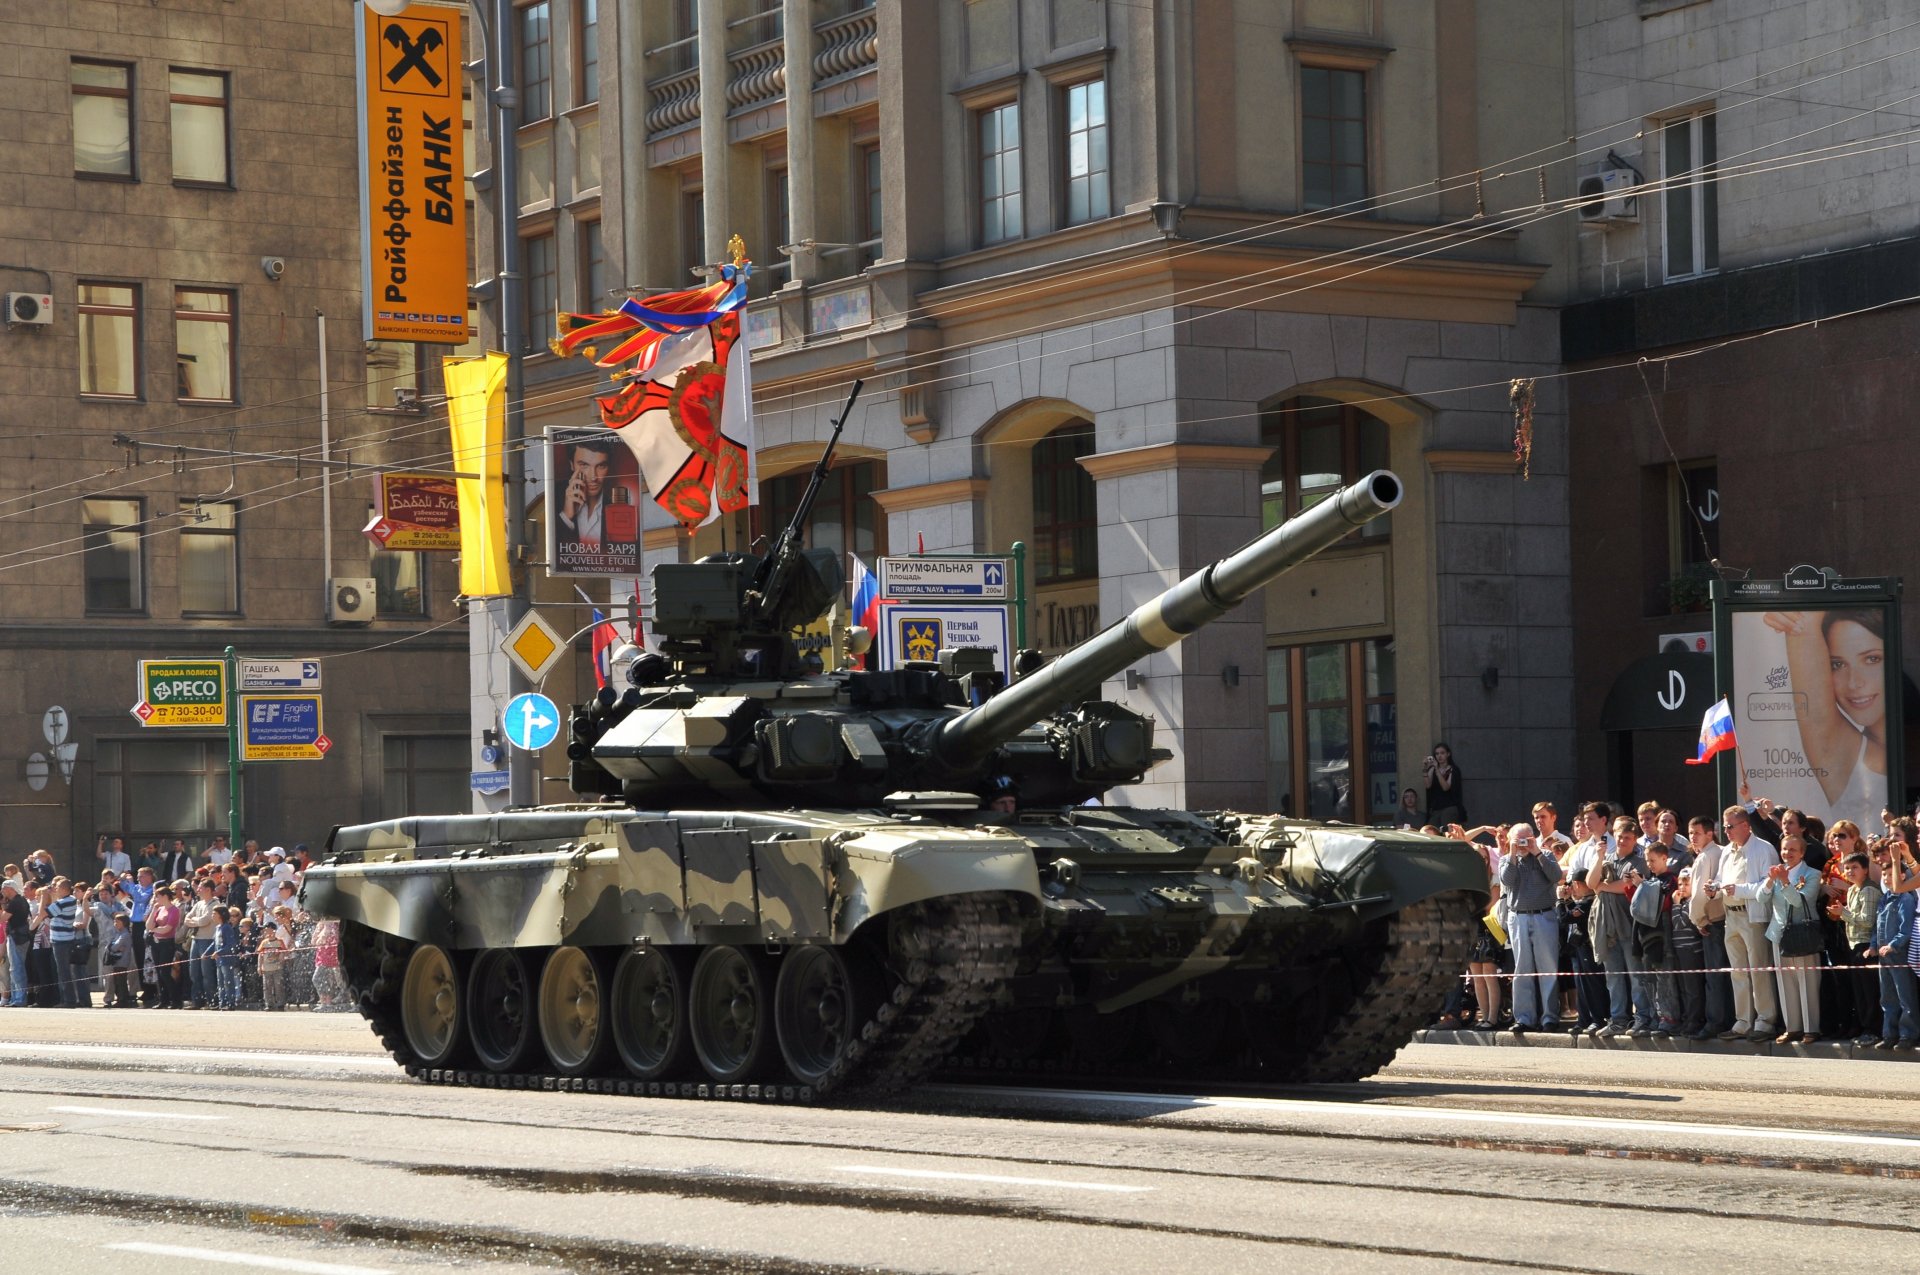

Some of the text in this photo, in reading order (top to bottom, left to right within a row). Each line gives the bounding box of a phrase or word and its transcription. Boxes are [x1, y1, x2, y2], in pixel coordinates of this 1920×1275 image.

[423, 110, 453, 225] БАНК
[382, 107, 411, 303] Райффайзен
[559, 542, 636, 555] НОВАЯ ЗАРЯ
[559, 556, 636, 566] NOUVELLE ETOILE
[888, 562, 974, 573] ТРИУМФАЛЬНАЯ
[888, 573, 922, 581] площадь
[947, 620, 978, 631] ПЕРВЫЙ
[947, 632, 981, 643] ЧЕШСКО-
[150, 669, 184, 677] ПРОДАЖА
[244, 665, 280, 673] ГАШЕКА
[172, 680, 217, 697] РЕСО
[170, 706, 222, 716] 730-30-00
[252, 703, 281, 723] EF
[283, 703, 313, 714] English
[282, 713, 301, 723] First
[487, 750, 492, 760] 5
[1763, 748, 1804, 765] 100%
[1744, 765, 1829, 781] уверенность
